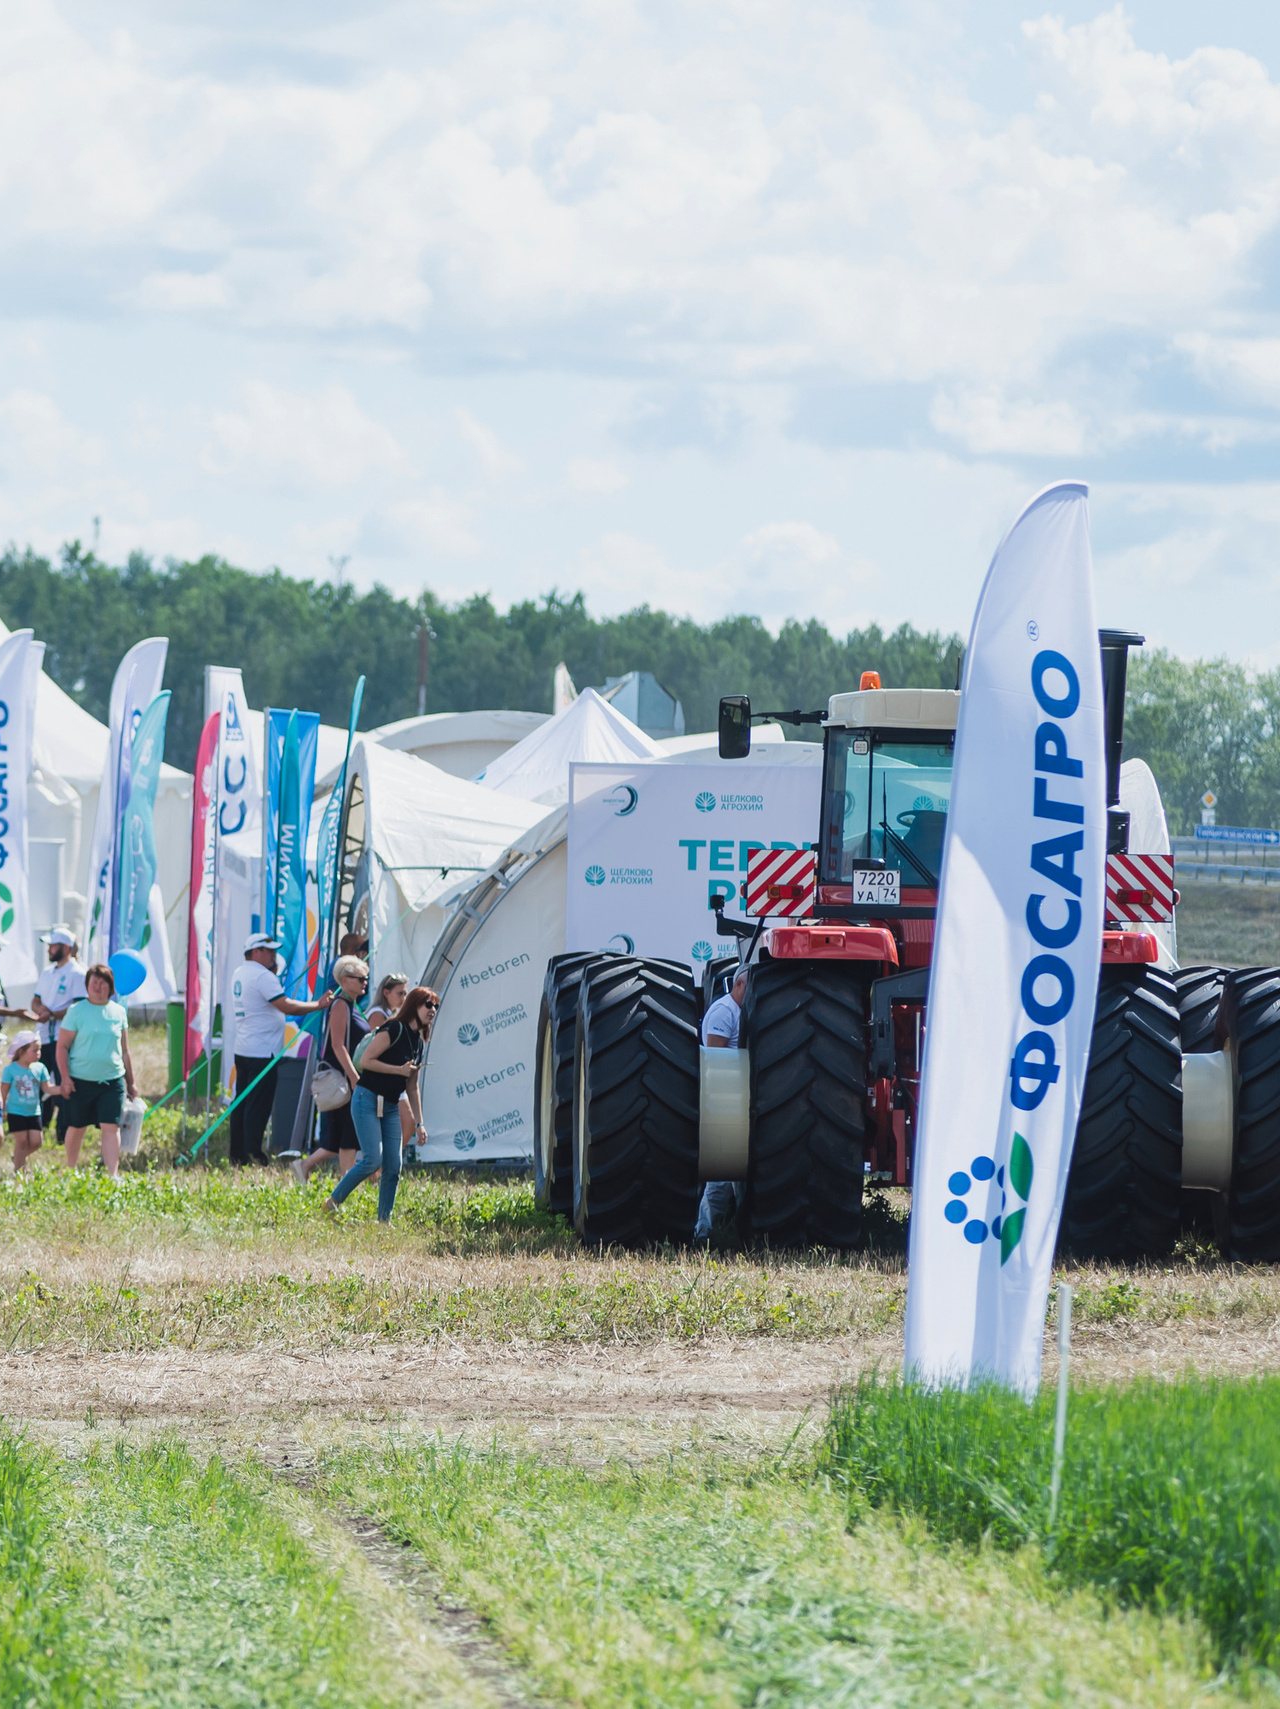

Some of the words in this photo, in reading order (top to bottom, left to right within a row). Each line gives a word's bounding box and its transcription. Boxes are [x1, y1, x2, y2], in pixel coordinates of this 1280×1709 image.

[720, 794, 764, 804] ЩЕЛКОВО
[720, 803, 764, 811] АГРОХИМ
[610, 867, 653, 877] ЩЕЛКОВО
[610, 876, 653, 885] АГРОХИМ
[859, 872, 895, 886] 7220
[1009, 650, 1084, 1111] ФОСАГРО
[883, 887, 897, 899] 74
[459, 953, 530, 989] #betaren
[481, 1003, 524, 1028] ЩЕЛКОВО
[485, 1011, 528, 1036] АГРОХИМ
[455, 1062, 526, 1098] #betaren
[477, 1109, 521, 1134] ЩЕЛКОВО
[481, 1117, 524, 1142] АГРОХИМ
